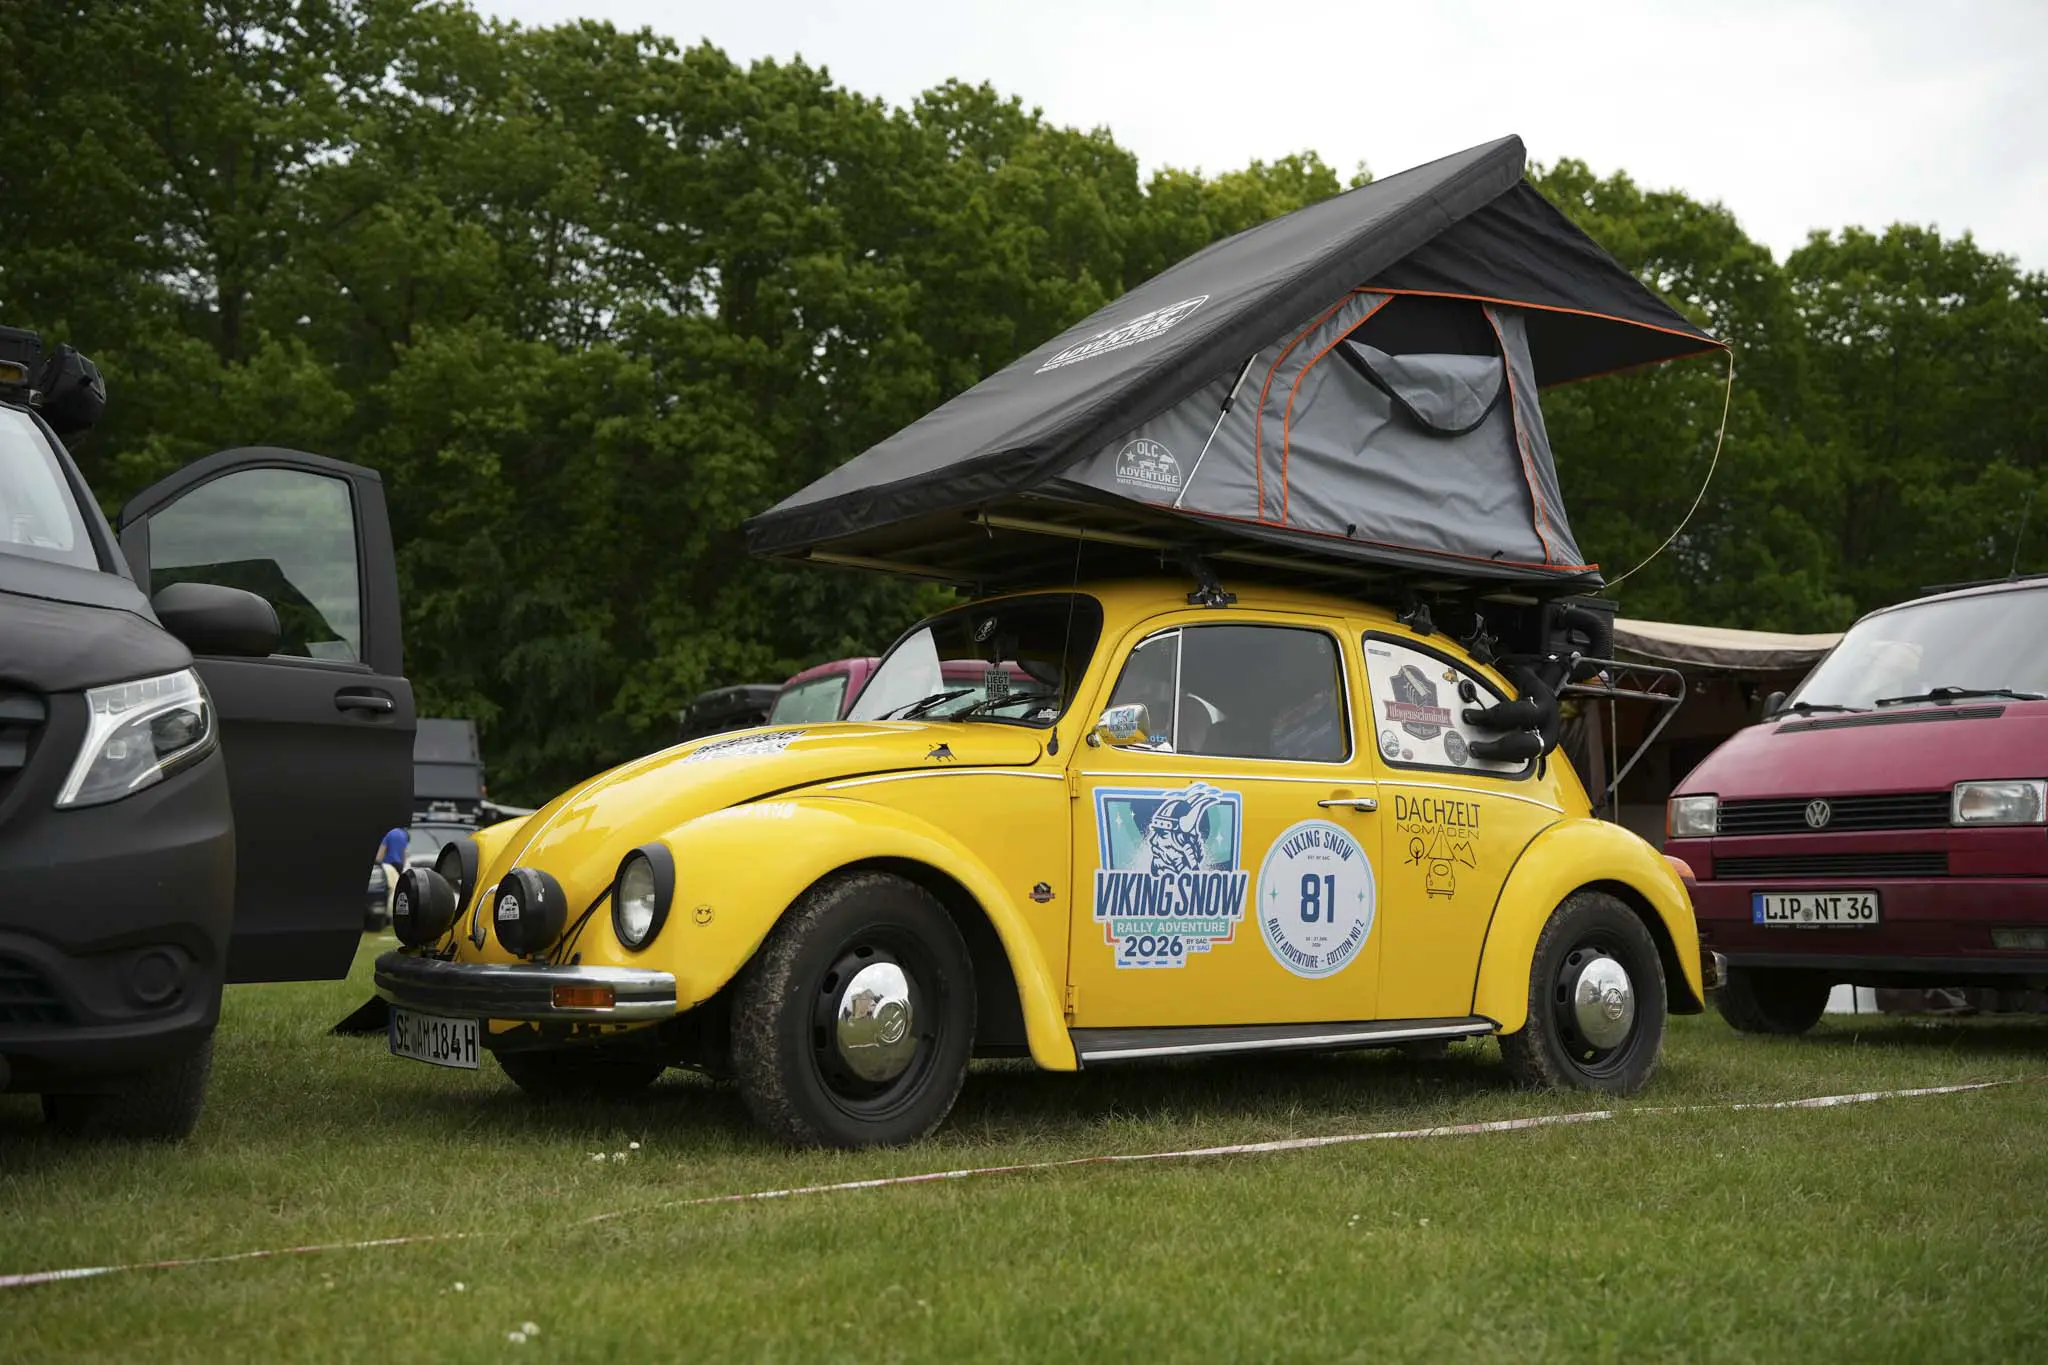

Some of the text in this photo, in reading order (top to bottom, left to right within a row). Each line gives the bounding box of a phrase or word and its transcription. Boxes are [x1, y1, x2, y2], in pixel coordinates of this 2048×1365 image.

[1137, 441, 1158, 458] OLC
[1119, 466, 1178, 484] ADVENTURE
[987, 676, 1008, 684] LIEGT
[987, 684, 1009, 693] HIER
[1395, 795, 1480, 828] DACHZELT
[1396, 822, 1479, 840] NOMADEN
[1282, 830, 1354, 862] VIKING SNOW
[1300, 873, 1335, 923] 81
[1765, 897, 1873, 920] LIP NT 36
[1117, 922, 1225, 933] RALLY ADVENTURE
[1124, 935, 1183, 957] 2026
[1268, 918, 1285, 944] RALLY
[1280, 941, 1318, 968] ADVENTURE
[1326, 938, 1353, 965] EDITION
[1349, 927, 1361, 942] NO
[1355, 919, 1365, 927] 2
[396, 1014, 410, 1052] SE
